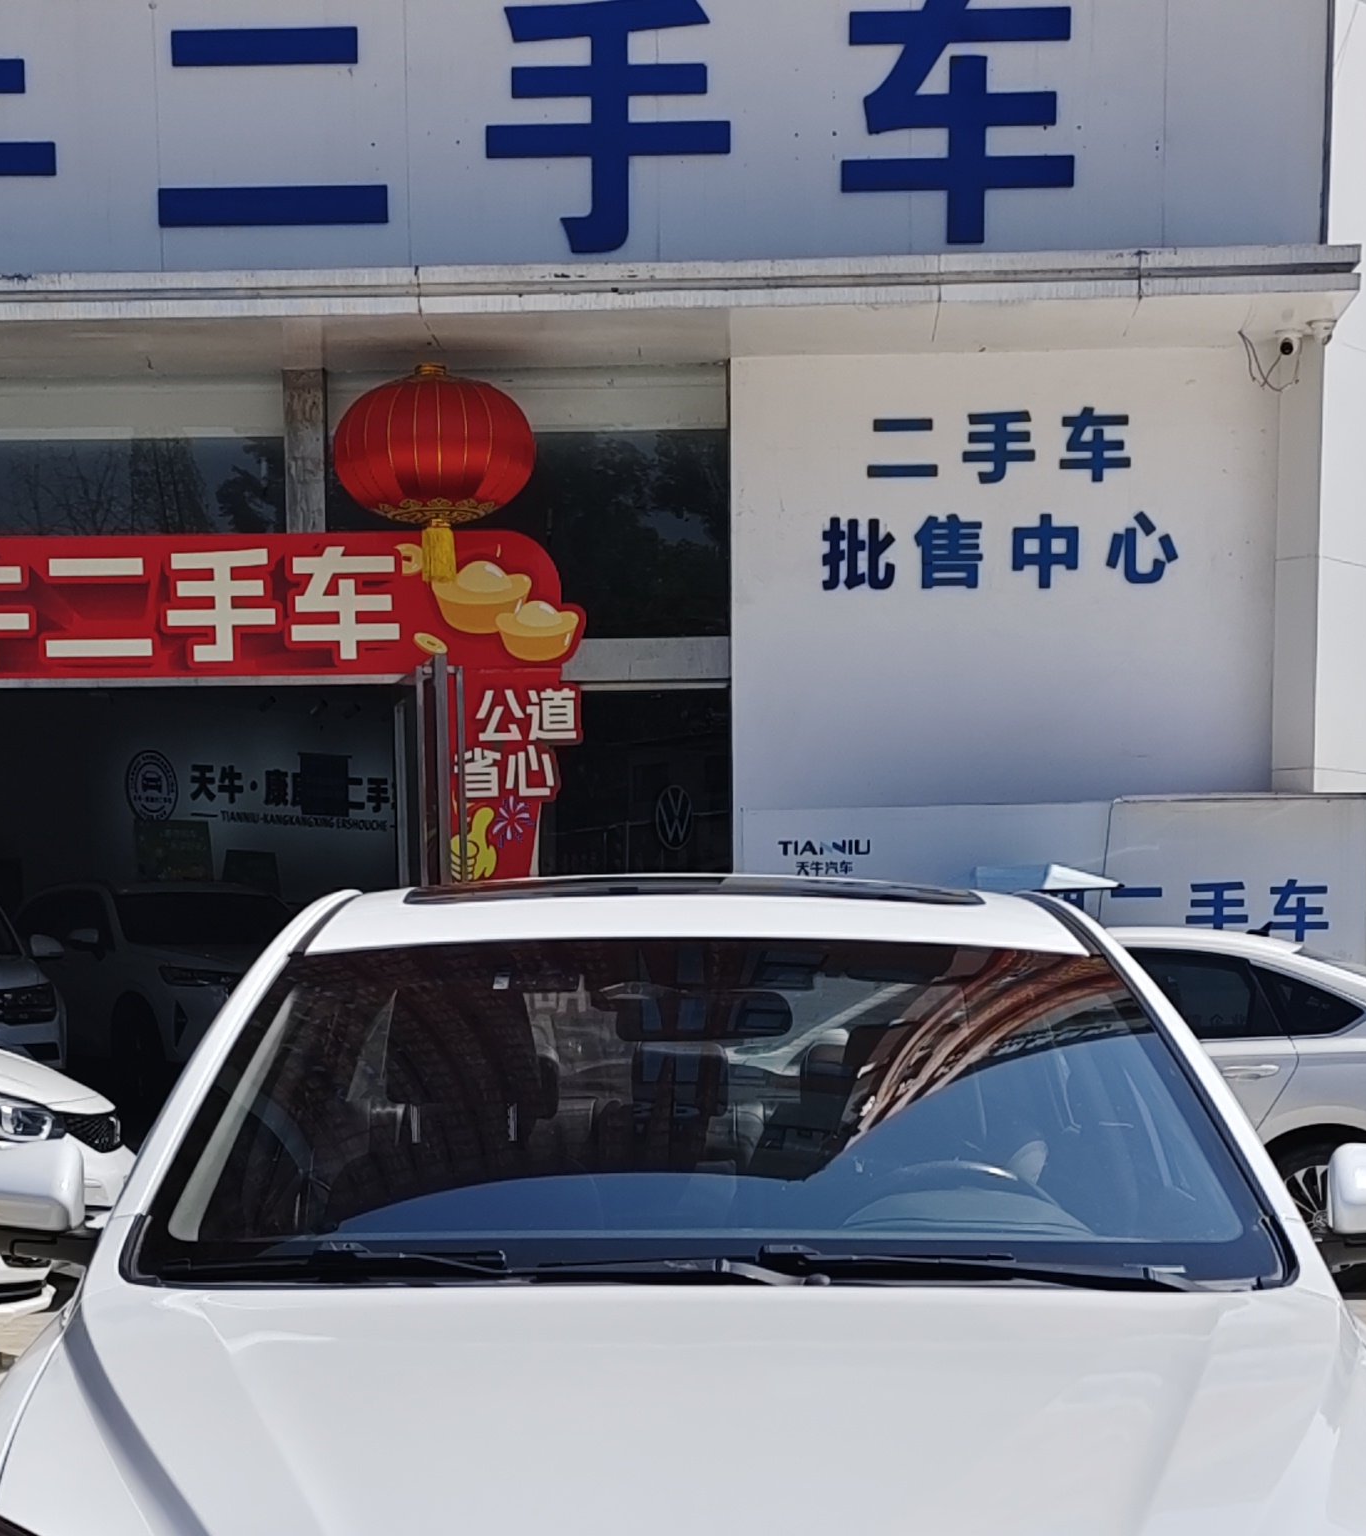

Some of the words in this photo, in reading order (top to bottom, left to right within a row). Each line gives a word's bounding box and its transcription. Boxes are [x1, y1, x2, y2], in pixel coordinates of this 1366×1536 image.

[866, 406, 1133, 484] 二手车
[821, 511, 1179, 592] 批售中心
[475, 687, 577, 742] 公道
[454, 744, 555, 798] 省心
[777, 839, 870, 856] TIANNIU
[795, 859, 853, 877] 天牛汽车
